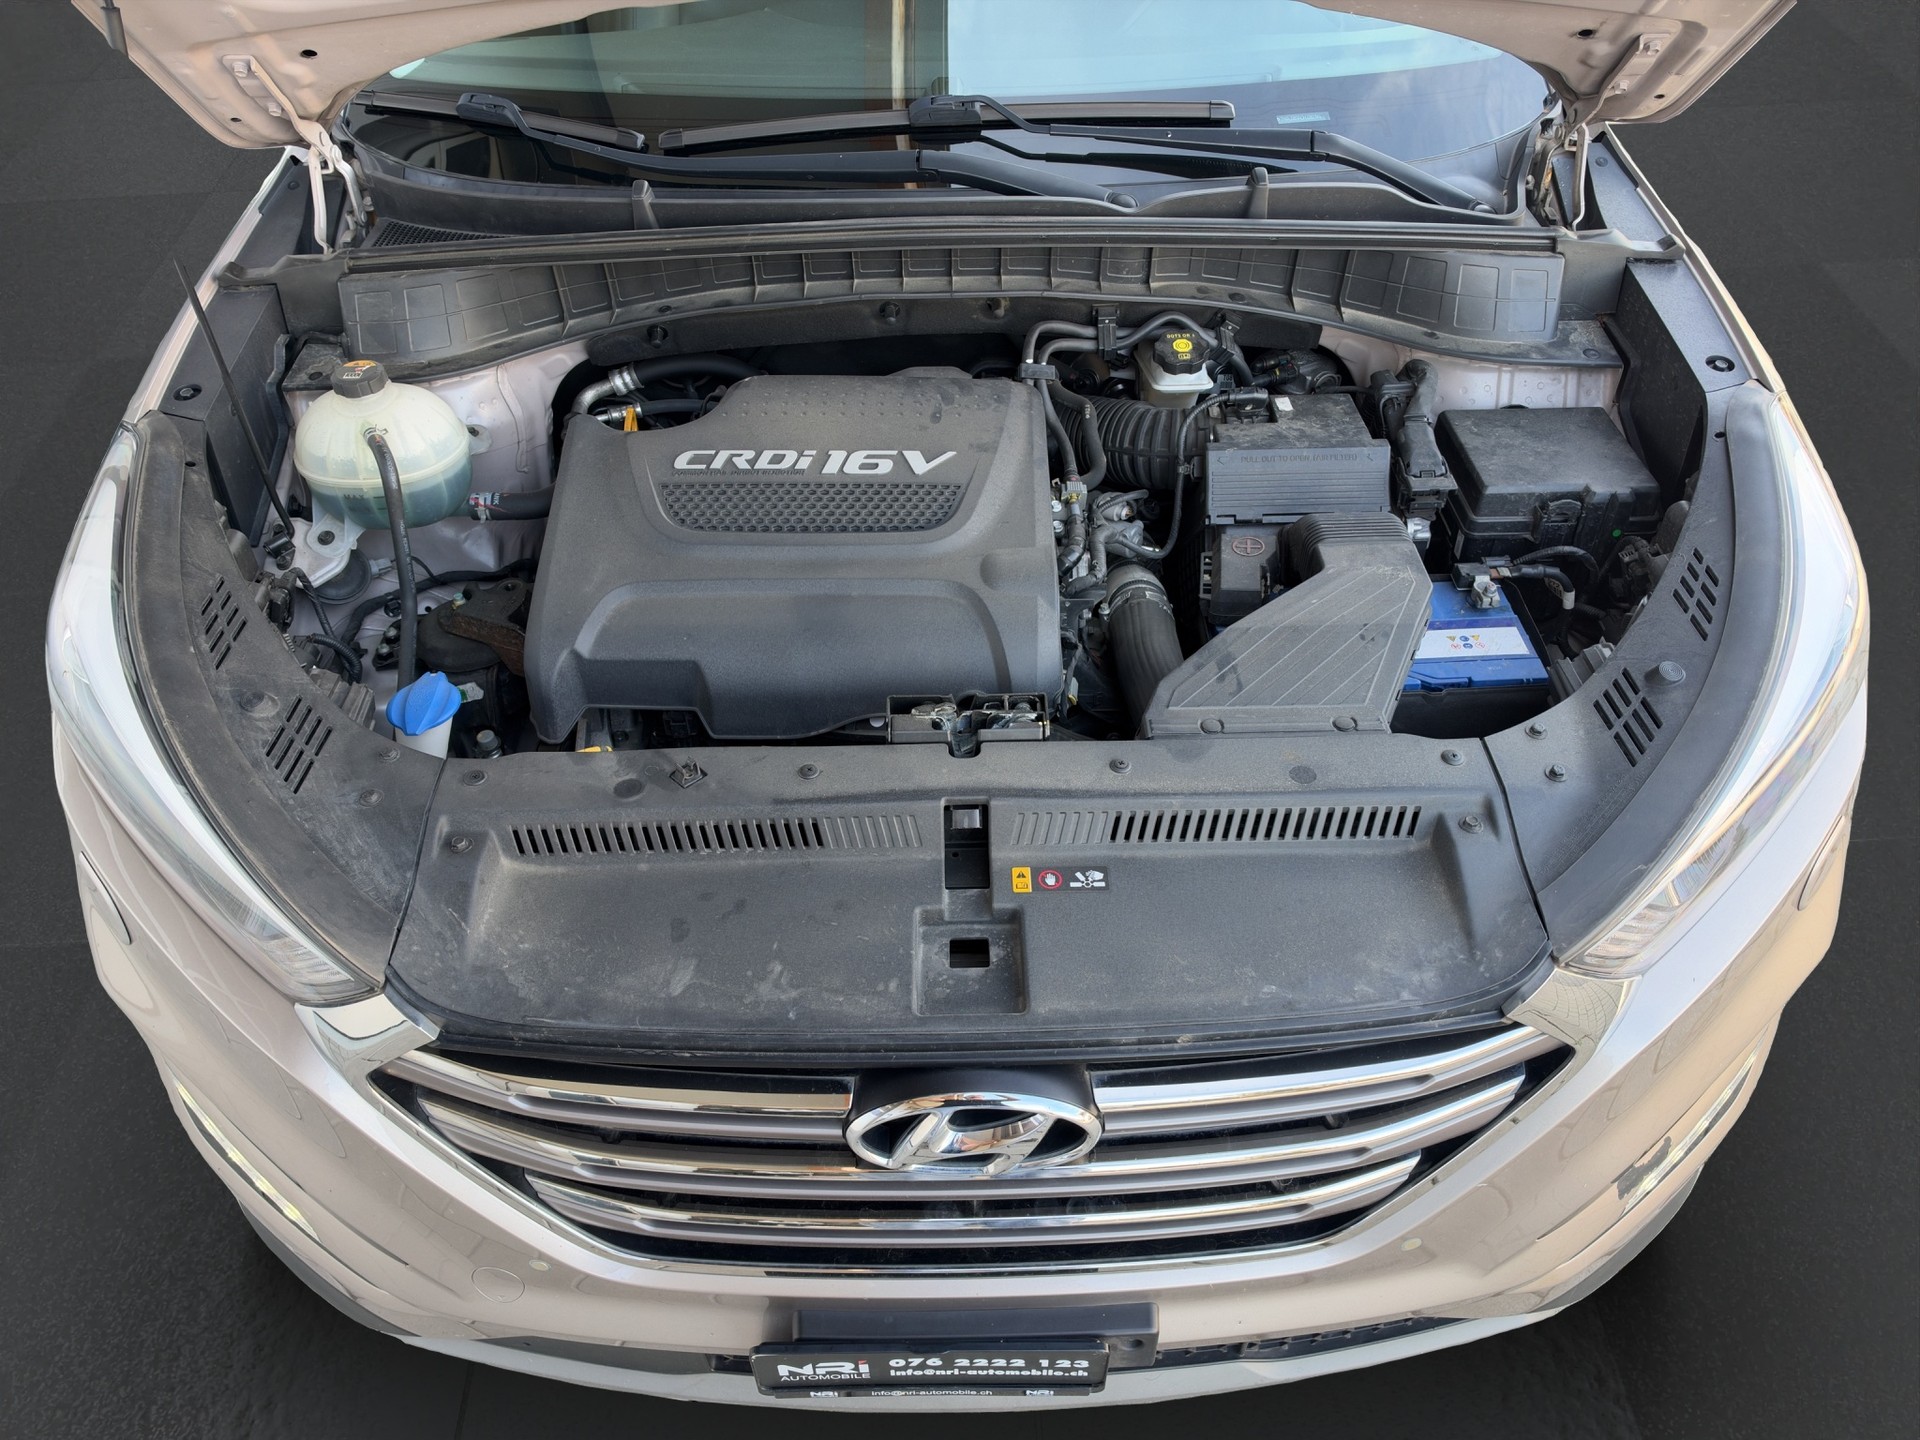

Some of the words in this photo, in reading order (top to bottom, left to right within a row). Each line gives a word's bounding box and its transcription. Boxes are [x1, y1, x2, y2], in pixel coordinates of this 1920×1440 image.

[673, 450, 817, 469] CRDi
[889, 1358, 942, 1367] 076
[953, 1358, 1026, 1367] 2222
[1039, 1359, 1089, 1368] 123
[781, 1373, 871, 1382] AUTOMOBILE
[890, 1369, 1089, 1377] info@nri-automobile.ch
